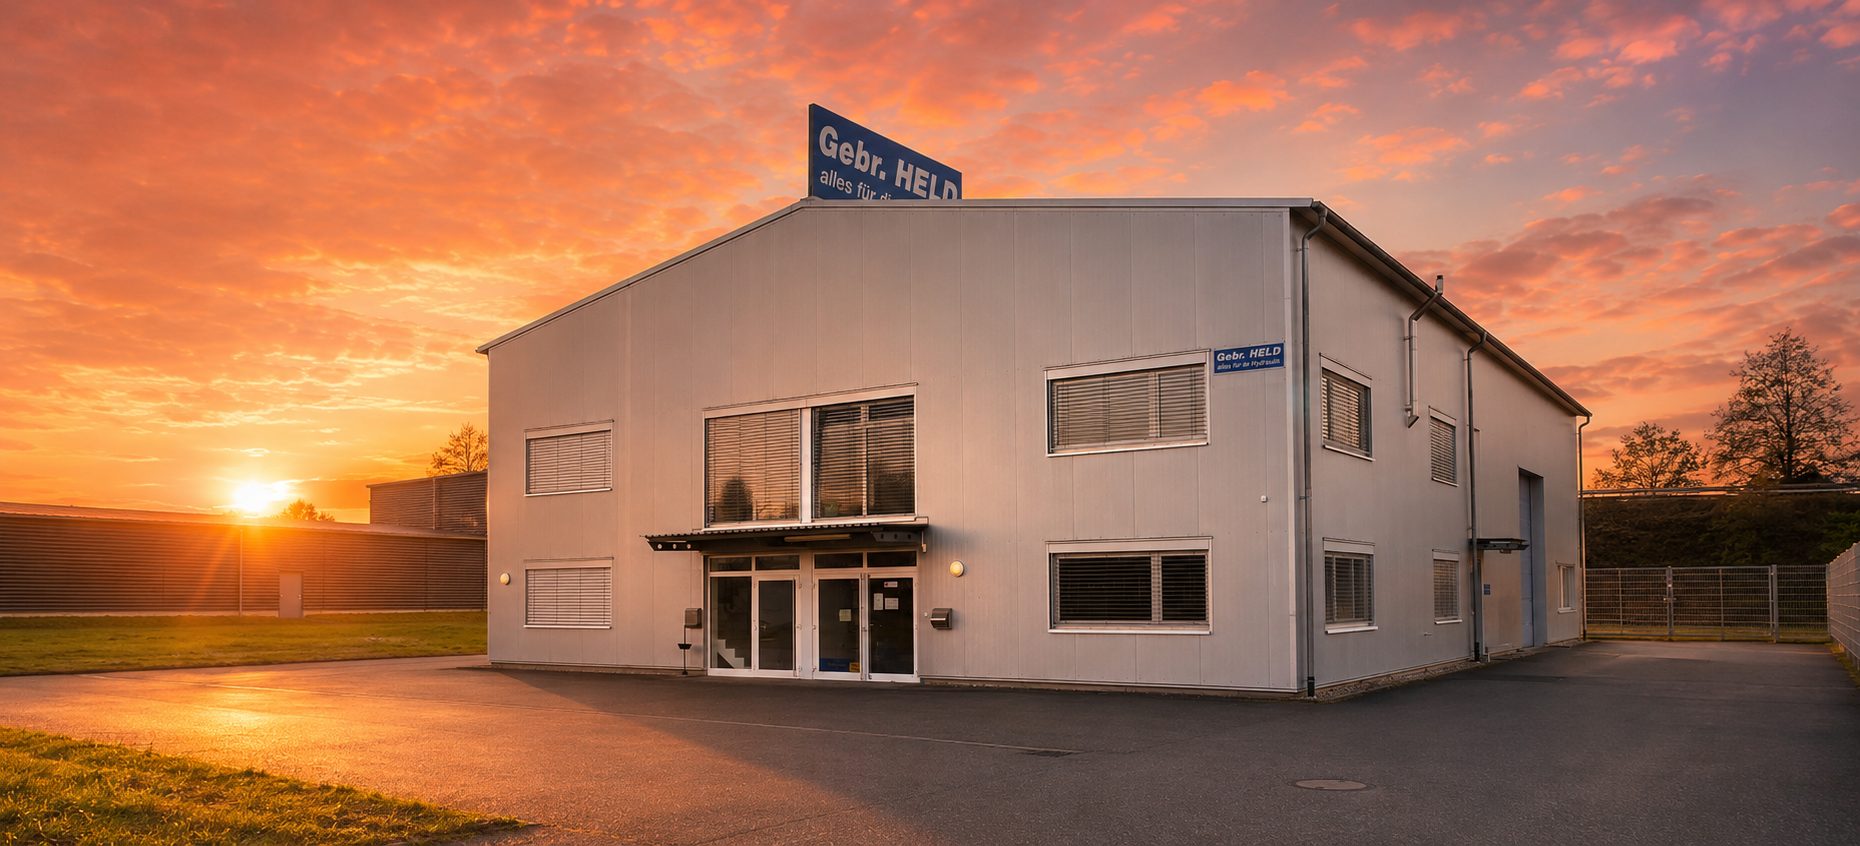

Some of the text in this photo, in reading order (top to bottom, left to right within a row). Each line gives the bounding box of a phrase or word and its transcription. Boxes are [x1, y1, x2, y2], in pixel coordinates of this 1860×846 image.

[819, 125, 958, 200] Gebr. HELD
[820, 170, 852, 194] alles
[857, 182, 877, 200] für
[1217, 347, 1281, 362] Gebr. HELD
